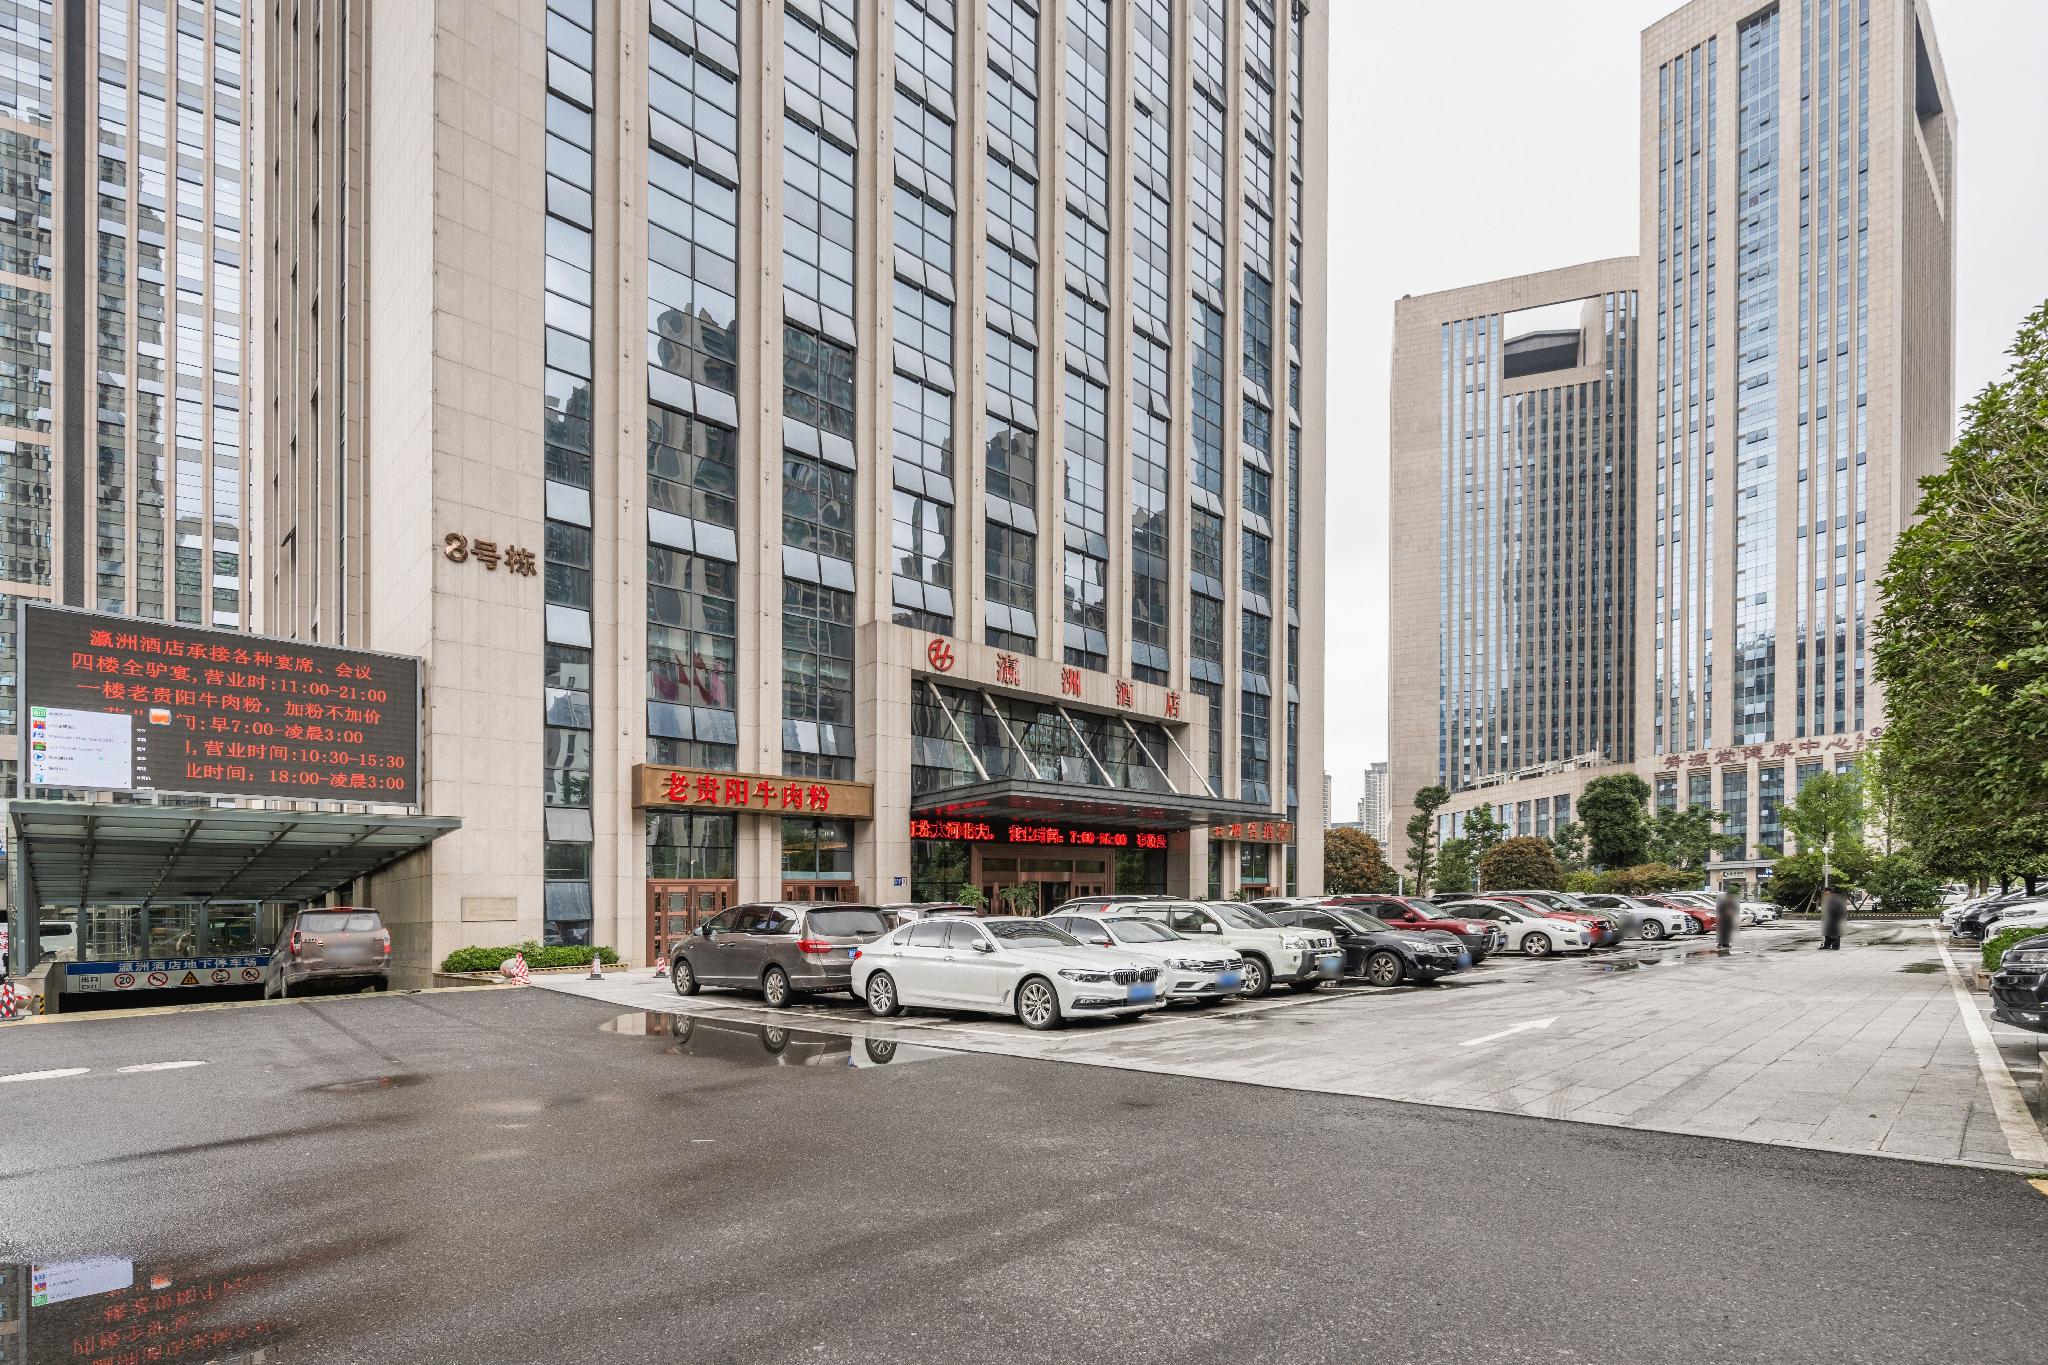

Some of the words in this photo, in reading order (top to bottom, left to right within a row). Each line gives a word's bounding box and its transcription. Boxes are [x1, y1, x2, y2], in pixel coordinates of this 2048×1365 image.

[996, 652, 1181, 719] 瀛洲酒店
[661, 772, 830, 812] 老贵阳牛肉粉
[118, 958, 257, 973] 瀛洲酒店地下停车场
[119, 976, 131, 985] 20
